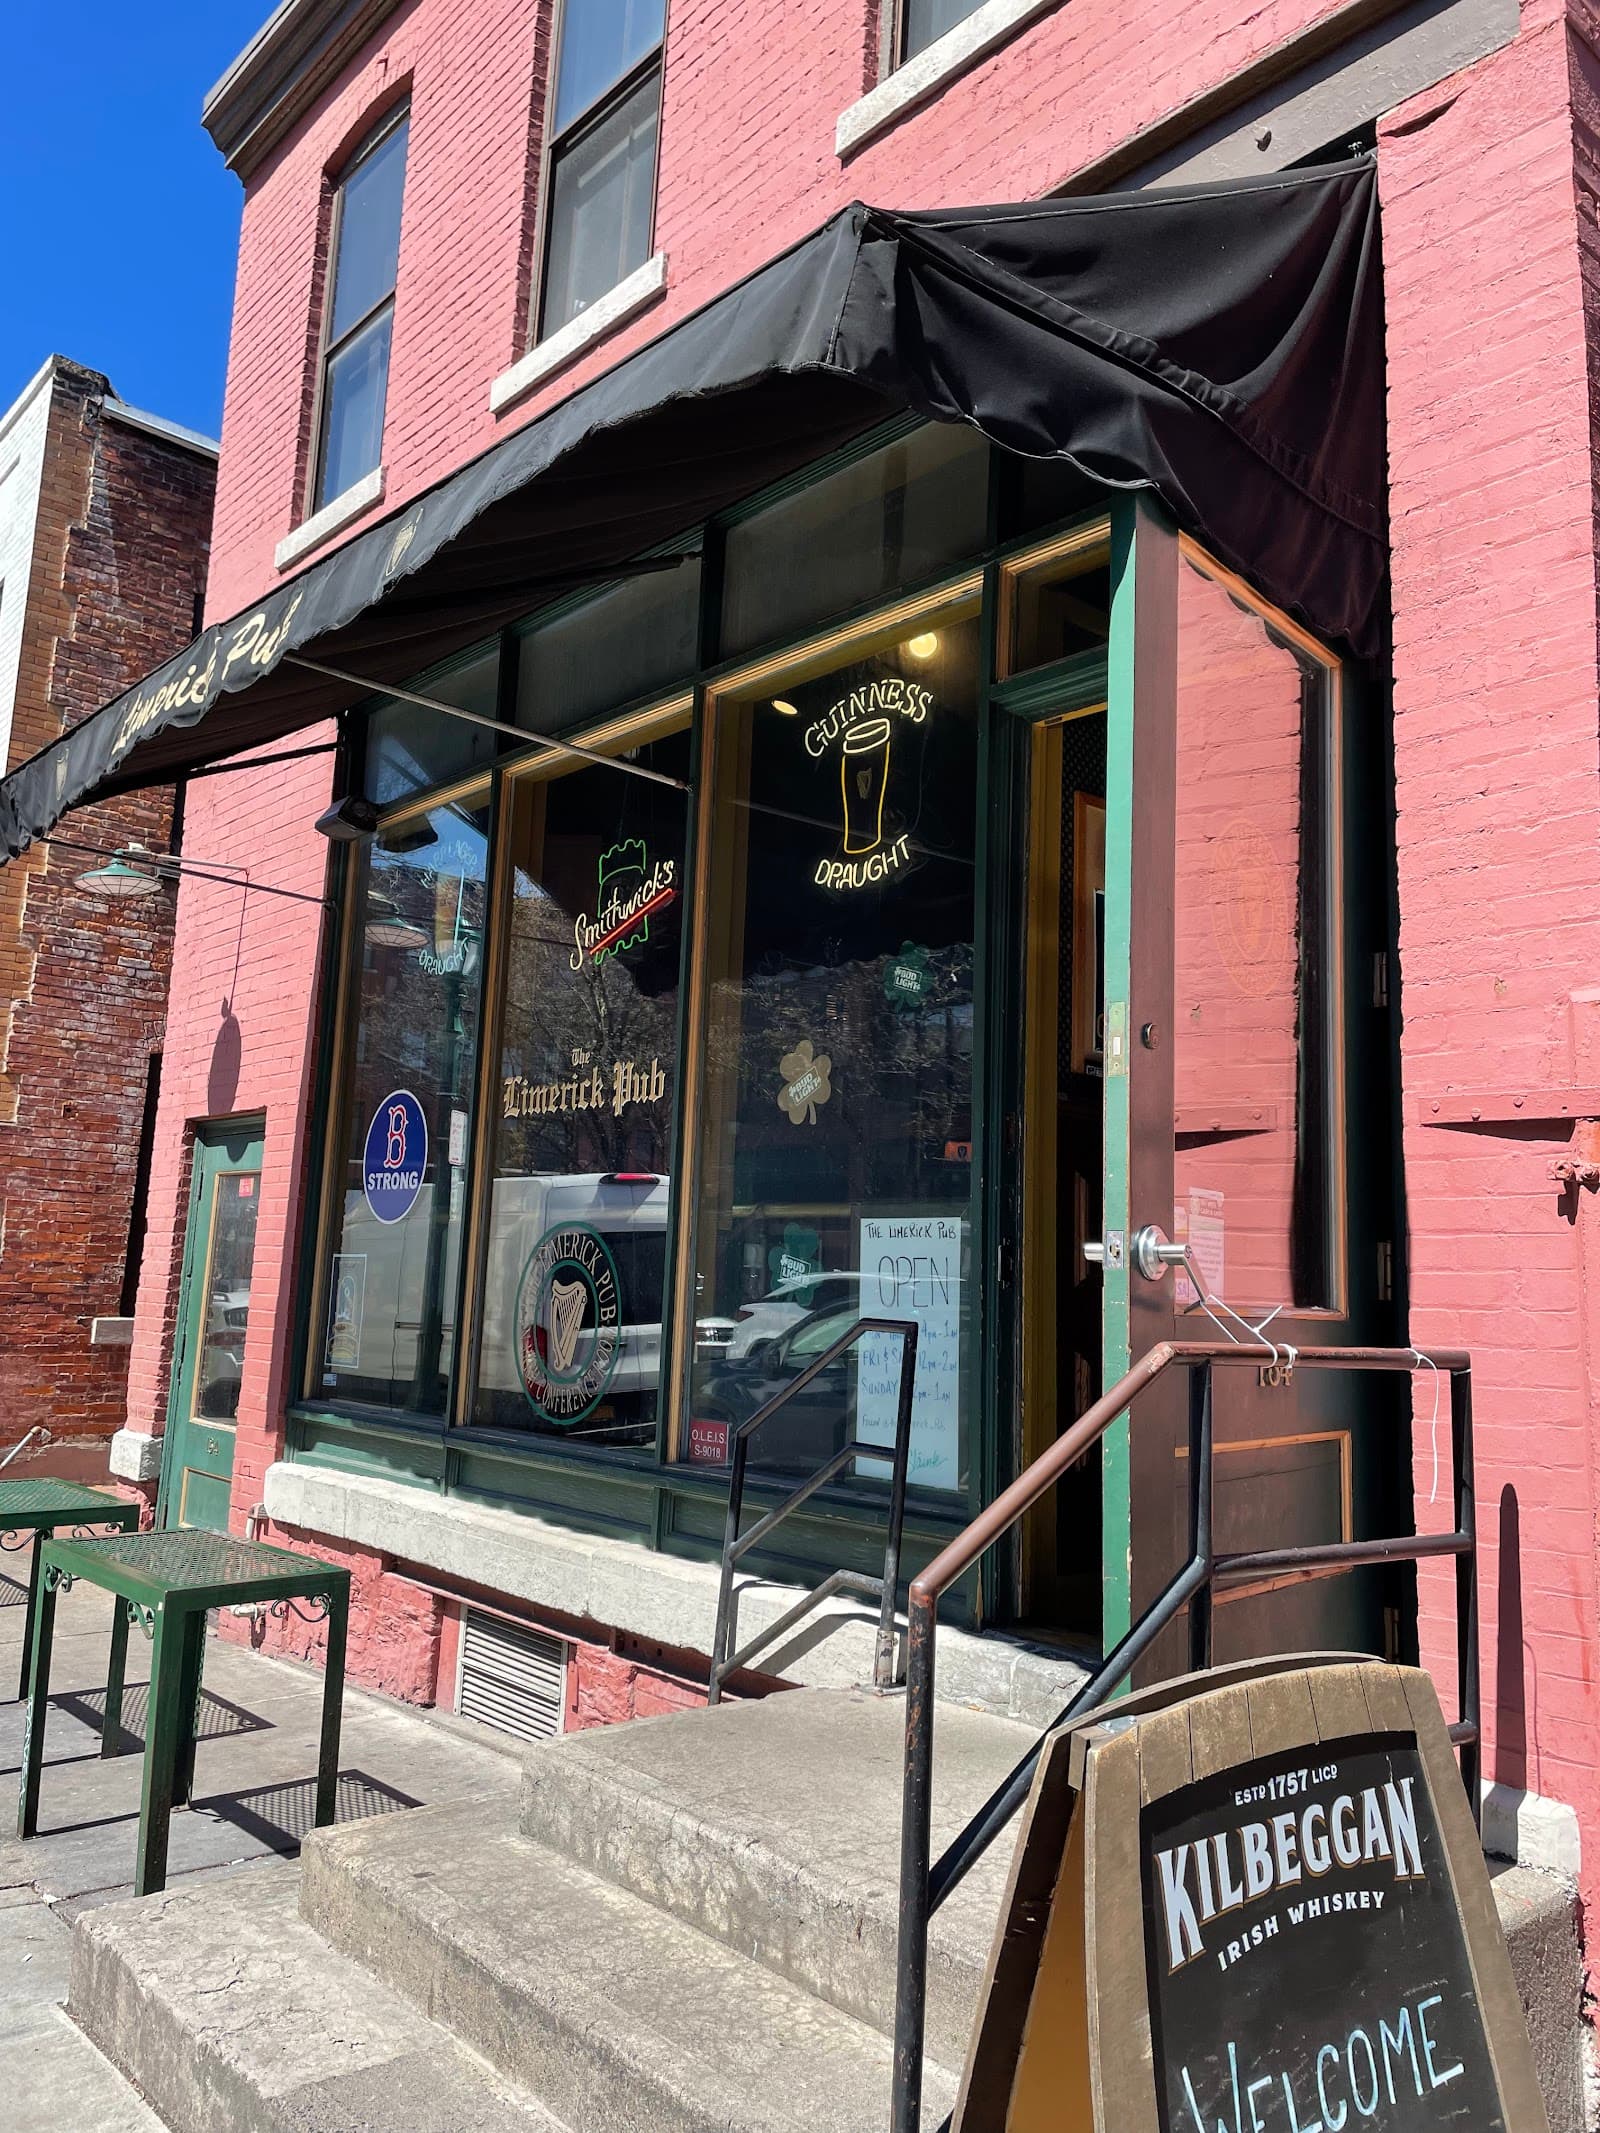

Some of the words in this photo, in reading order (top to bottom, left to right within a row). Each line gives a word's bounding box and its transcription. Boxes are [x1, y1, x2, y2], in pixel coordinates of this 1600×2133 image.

[804, 678, 934, 758] GUINNESS
[814, 833, 911, 890] DRAUGHT
[570, 859, 674, 971] Smithwick's
[418, 936, 469, 976] DRAUGHT
[901, 969, 917, 981] BUD
[895, 976, 919, 990] LIGHT
[571, 1048, 592, 1068] The
[503, 1066, 605, 1118] Limerick
[612, 1057, 666, 1117] Pub
[794, 1078, 819, 1103] LIGHT
[795, 1073, 813, 1092] BUD
[383, 1104, 409, 1169] B
[367, 1171, 419, 1191] STRONG
[865, 1222, 883, 1239] THE
[538, 1232, 604, 1276] LIMERICK
[595, 1268, 617, 1321] PUB
[787, 1258, 806, 1274] BUD
[879, 1255, 949, 1308] OPEN
[535, 1368, 599, 1414] CONFERENCE
[862, 1377, 898, 1397] SUNDAY
[694, 1444, 721, 1459] S-9018
[1267, 1768, 1309, 1801] 1757
[1154, 1777, 1425, 1976] KILBEGGAN
[1217, 1915, 1279, 1972] IRISH
[1287, 1890, 1385, 1925] WHISKEY
[1181, 1994, 1464, 2133] WELCOME
